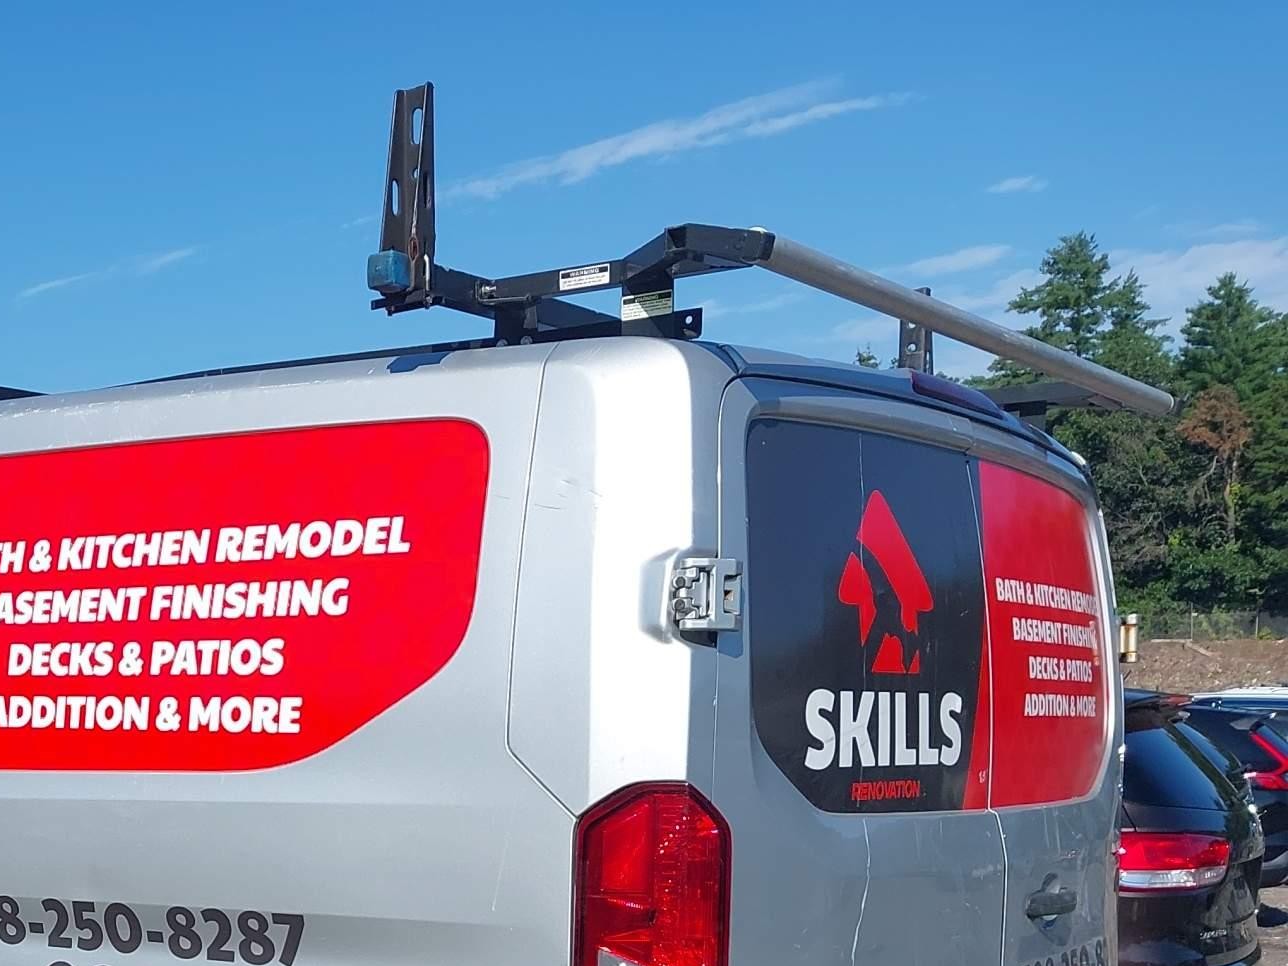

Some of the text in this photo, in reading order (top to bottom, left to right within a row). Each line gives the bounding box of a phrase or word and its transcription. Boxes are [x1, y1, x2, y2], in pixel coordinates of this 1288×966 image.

[569, 267, 599, 277] WARNING
[29, 540, 52, 573] &
[58, 529, 211, 571] KITCHEN
[215, 516, 410, 563] REMODEL
[150, 578, 350, 621] FINISHING
[995, 577, 1024, 604] BATH
[1026, 582, 1033, 605] &
[1034, 584, 1071, 611] KITCHEN
[1012, 617, 1062, 644] BASEMENT
[8, 638, 286, 678] DECKS & PATIOS
[1028, 656, 1092, 683] DECKS & PATIOS
[156, 697, 182, 732] &
[188, 697, 303, 734] MORE
[1024, 693, 1096, 717] ADDITION & MORE
[804, 687, 963, 771] SKILLS
[851, 780, 920, 800] RENOVATION
